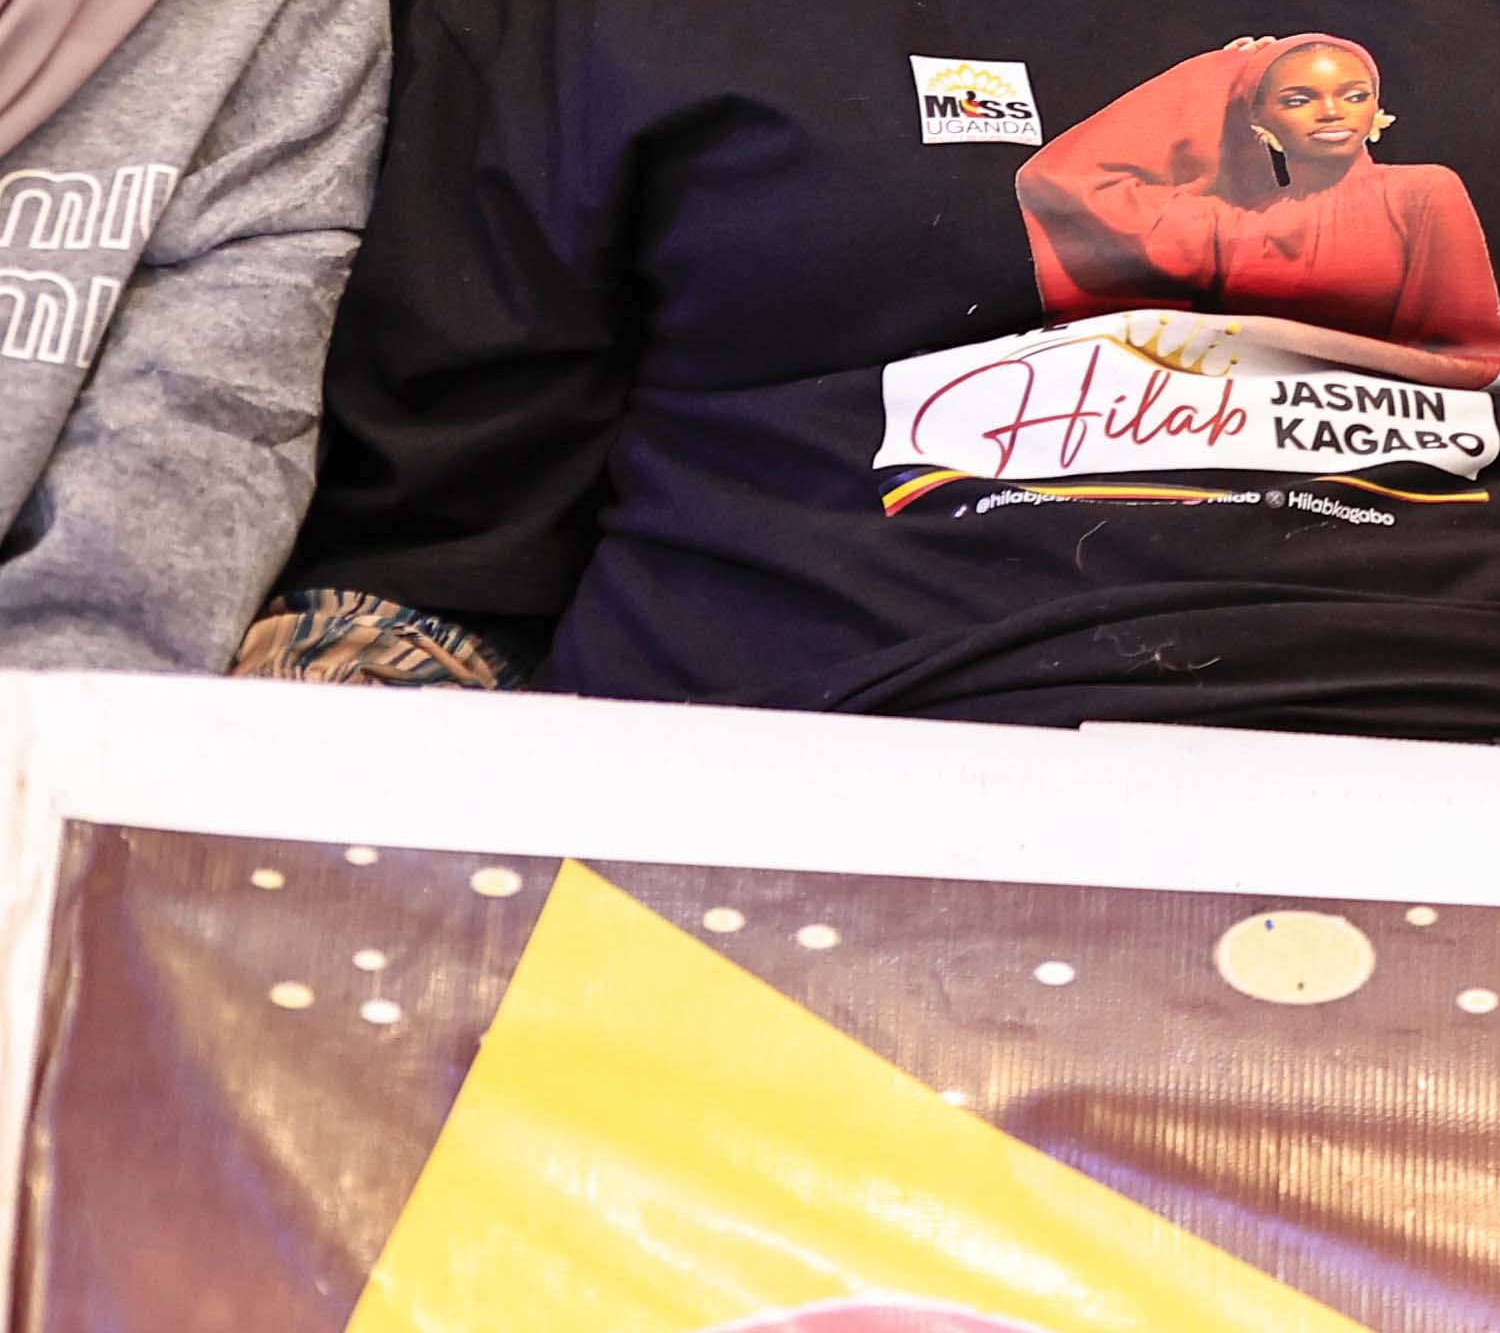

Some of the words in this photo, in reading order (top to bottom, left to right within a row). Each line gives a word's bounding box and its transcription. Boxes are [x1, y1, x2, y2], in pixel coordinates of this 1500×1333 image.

[926, 119, 1038, 136] UGANDA
[912, 344, 1247, 479] Hilab
[1271, 381, 1447, 424] JASMIN
[1274, 417, 1485, 458] KAGABO
